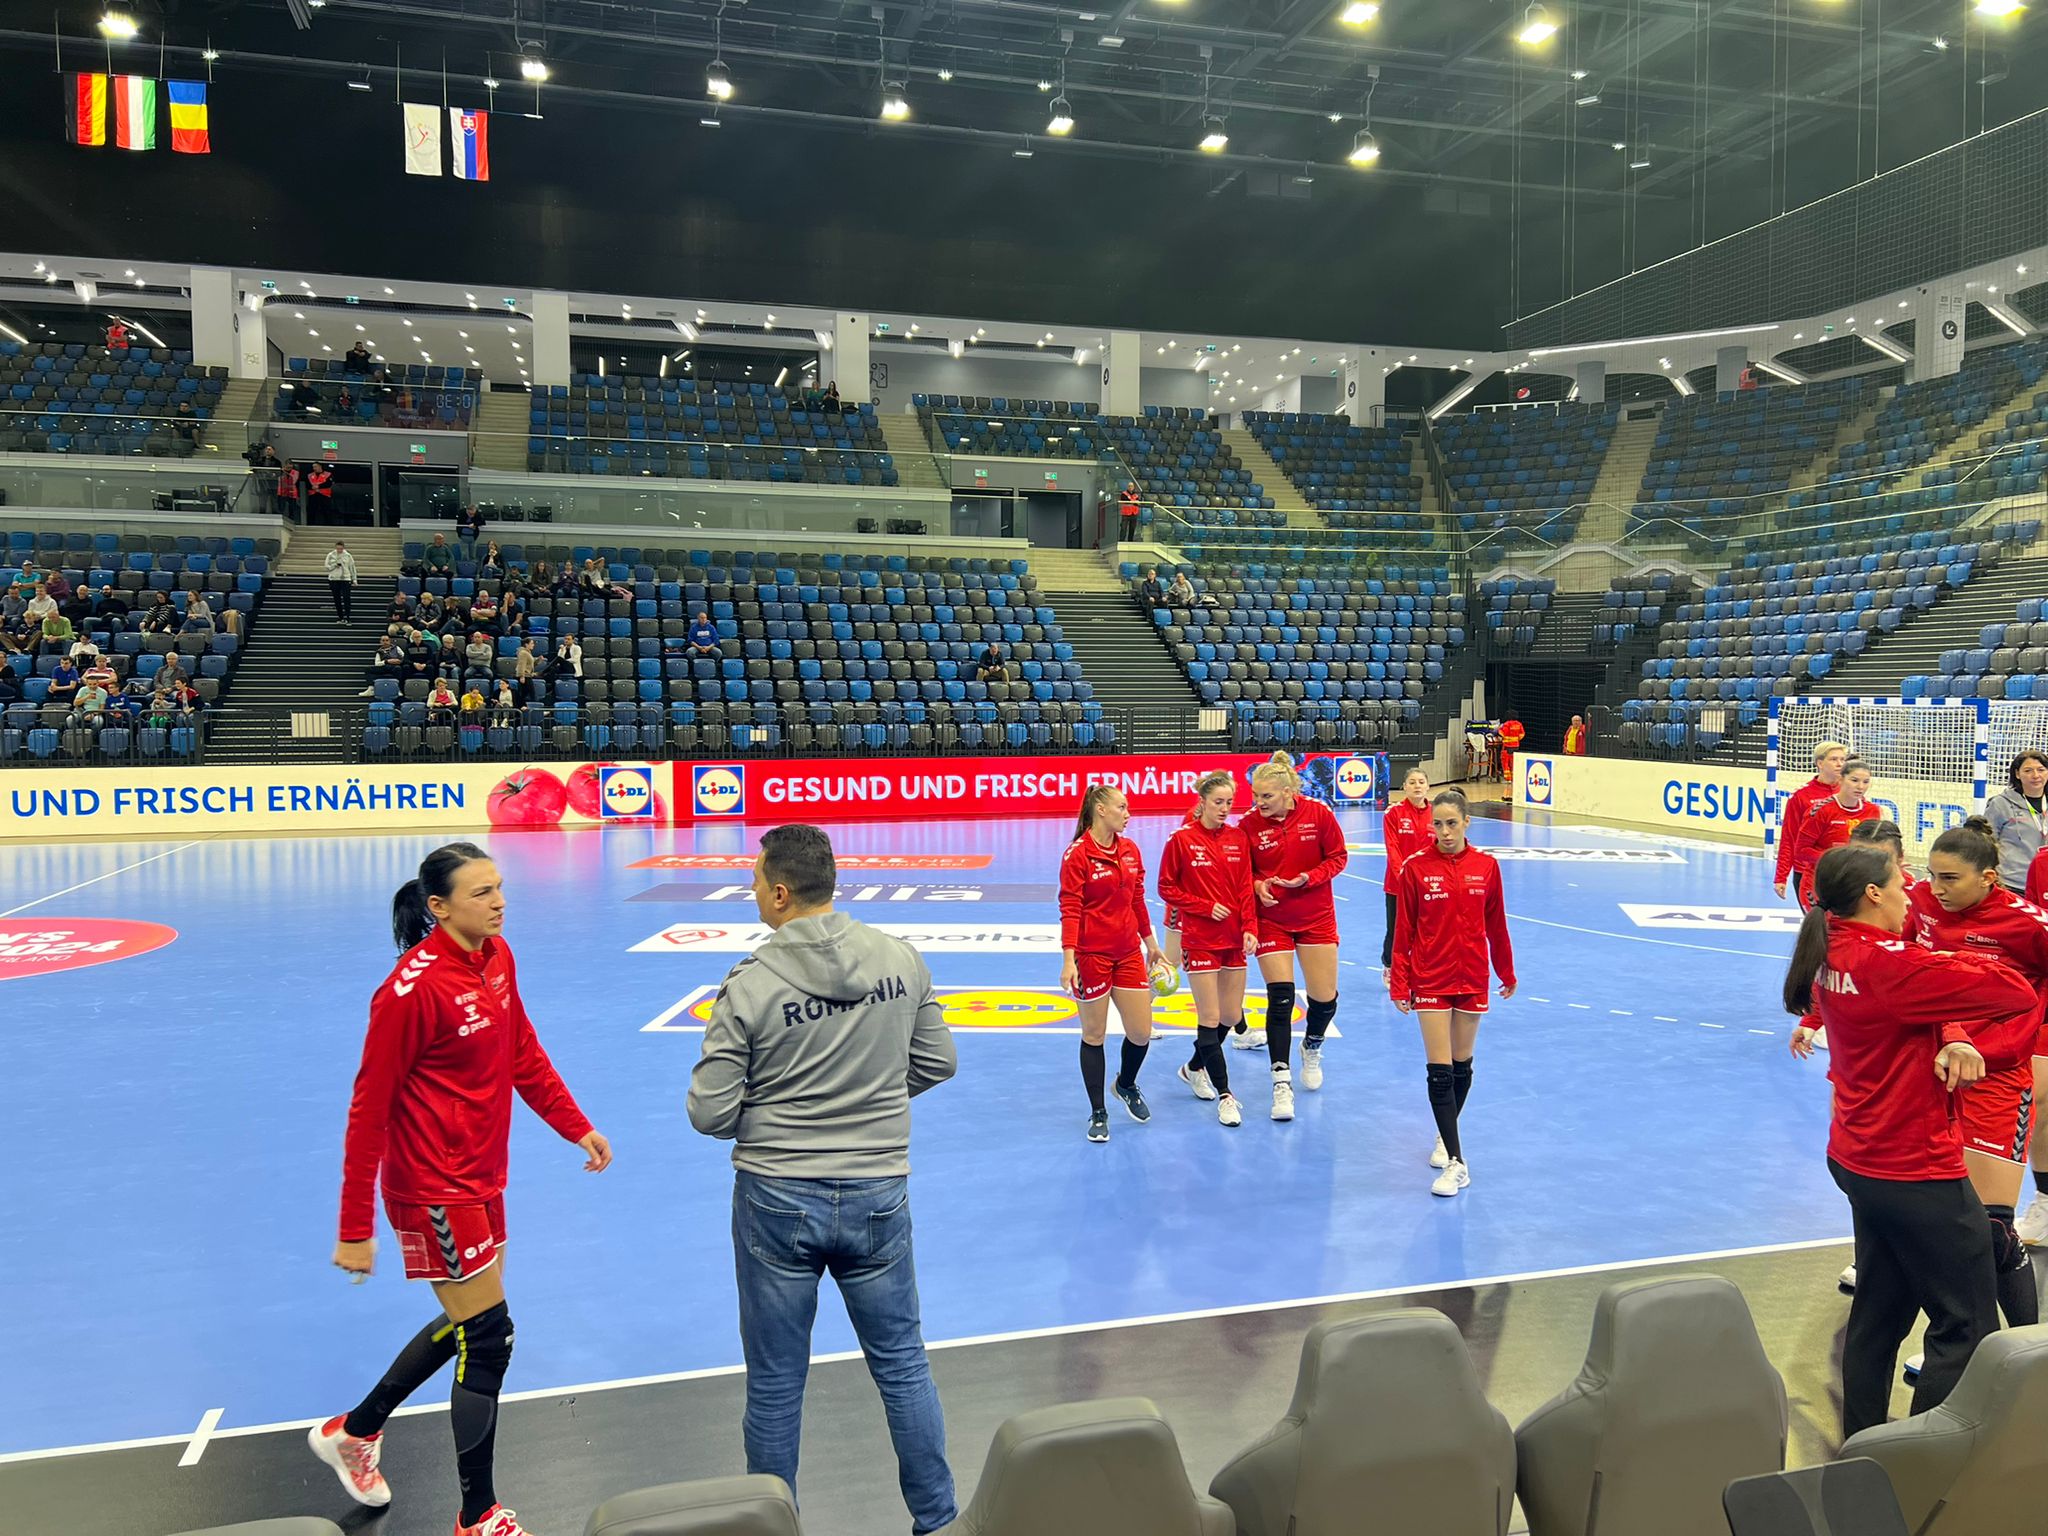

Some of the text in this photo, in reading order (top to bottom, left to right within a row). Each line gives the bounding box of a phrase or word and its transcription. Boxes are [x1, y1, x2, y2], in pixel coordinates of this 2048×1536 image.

[12, 778, 465, 817] UND FRISCH ERNÄHREN
[763, 776, 891, 803] GESUND
[900, 776, 966, 800] UND
[975, 773, 1077, 798] FRISCH
